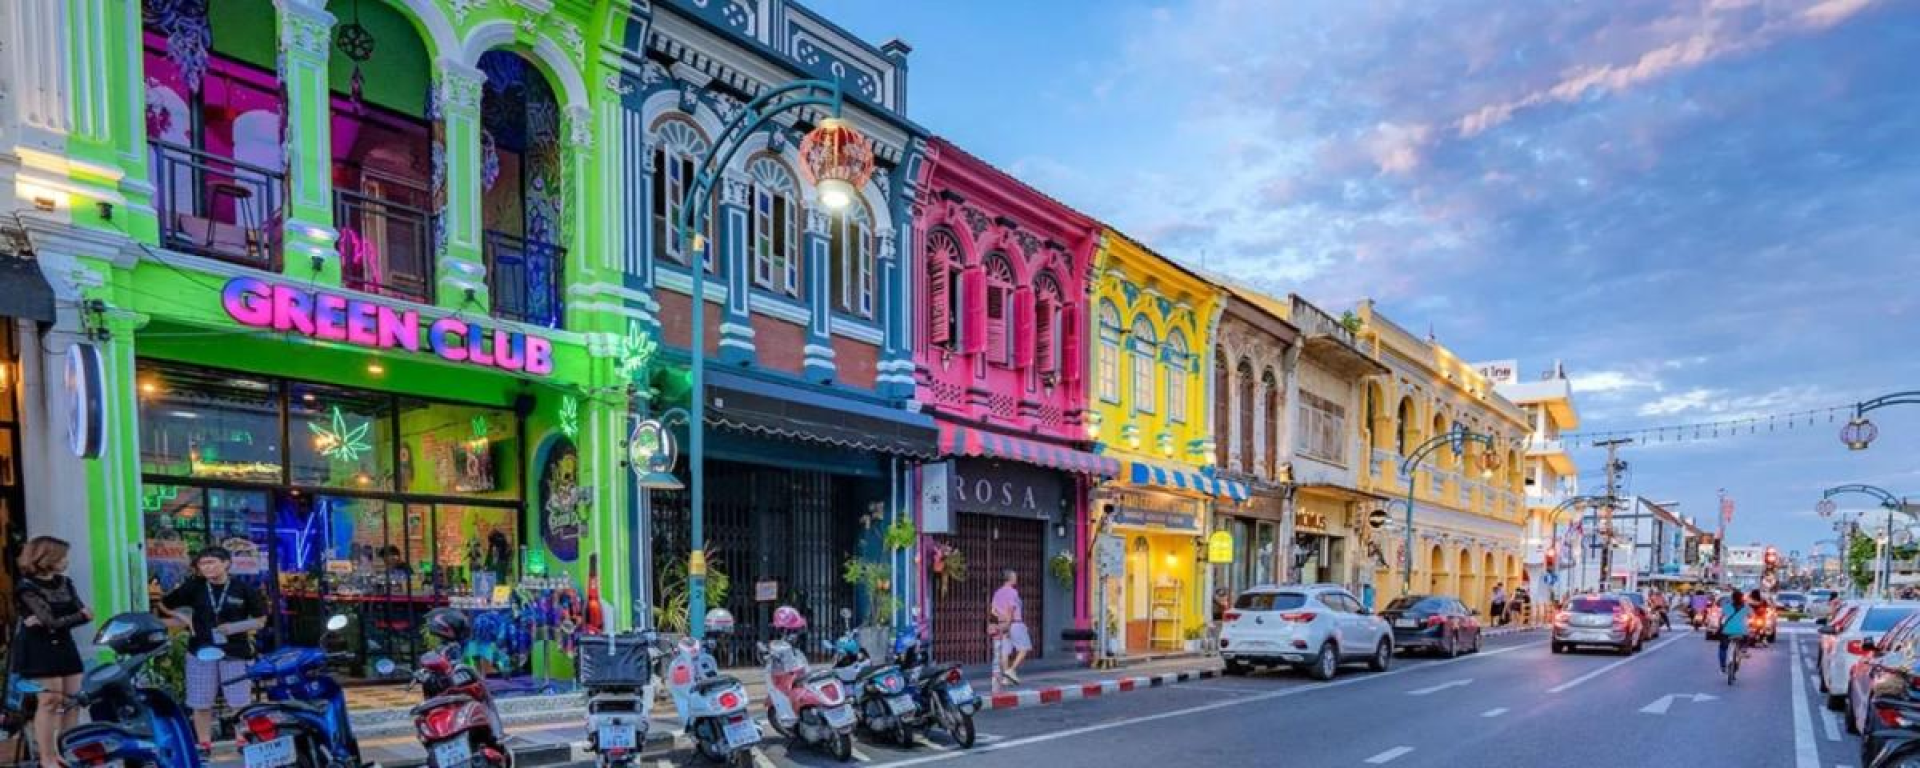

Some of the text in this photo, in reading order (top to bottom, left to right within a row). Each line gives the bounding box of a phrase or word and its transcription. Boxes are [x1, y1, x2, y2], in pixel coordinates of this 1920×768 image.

[222, 276, 553, 375] GREEN CLUB
[955, 475, 1037, 509] ROSA
